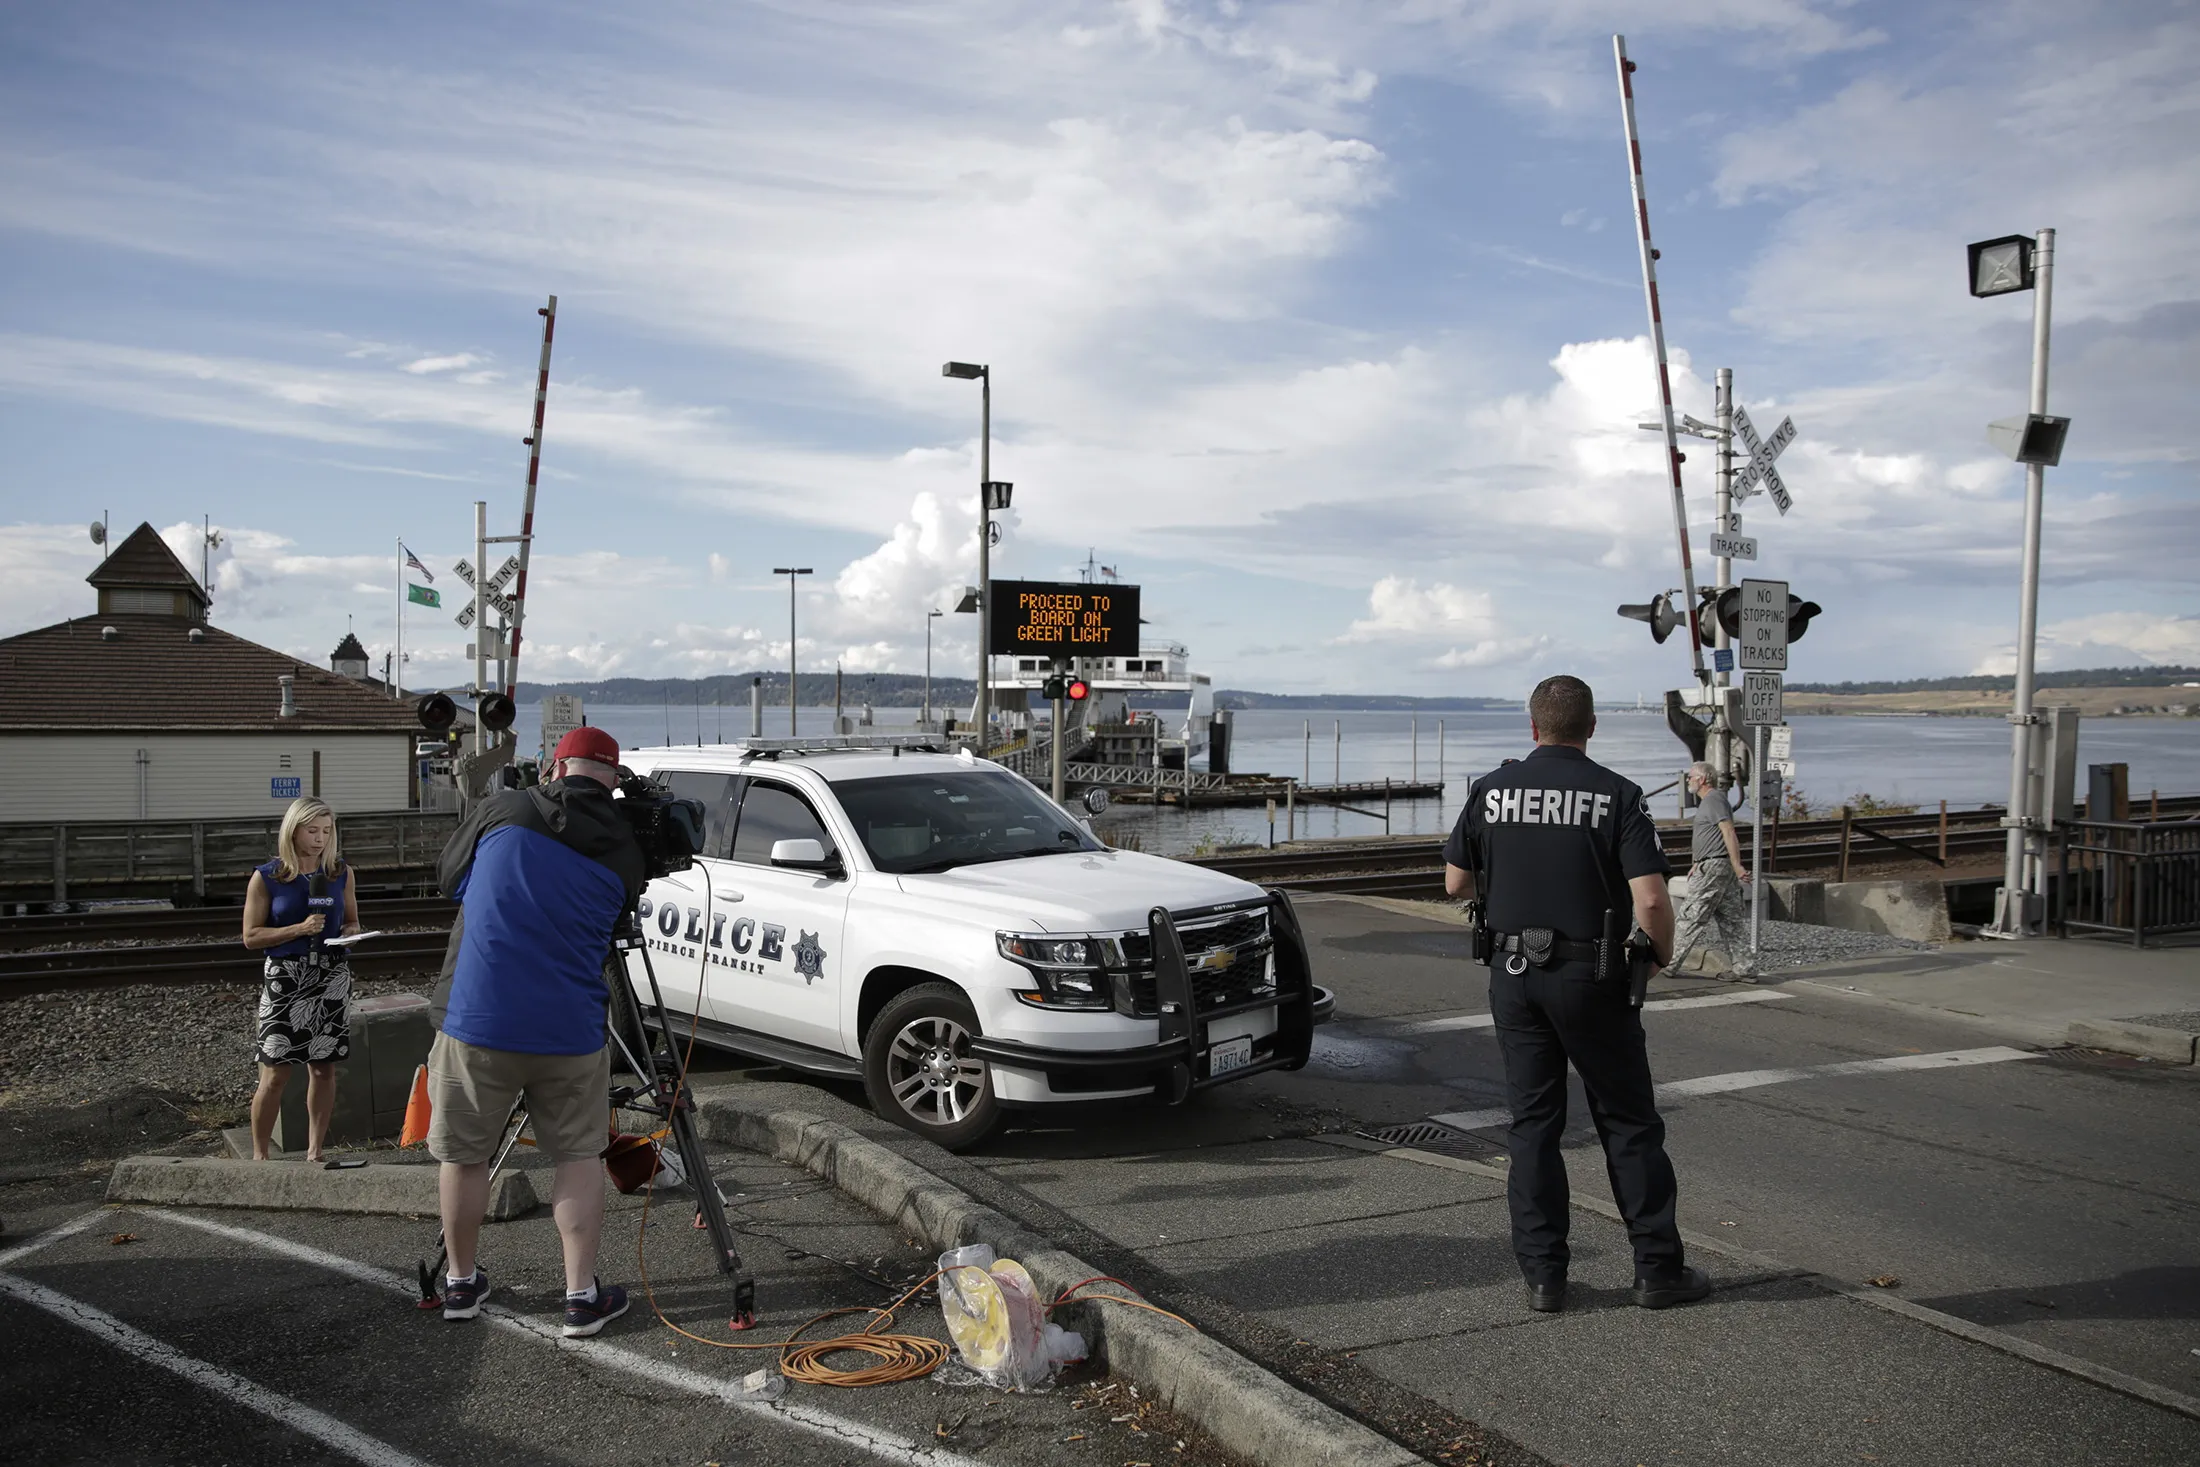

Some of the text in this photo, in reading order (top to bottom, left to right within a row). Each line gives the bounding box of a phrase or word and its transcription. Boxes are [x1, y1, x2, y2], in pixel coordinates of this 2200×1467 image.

[1734, 410, 1759, 456] RAIL
[1733, 421, 1794, 500] CROSSING
[1763, 467, 1790, 510] ROAD
[1730, 516, 1738, 532] 2
[1716, 539, 1752, 555] TRACKS
[456, 561, 476, 584] RAI
[458, 559, 519, 626] CRSING
[1757, 589, 1772, 604] NO
[491, 594, 514, 619] ROA
[1019, 593, 1110, 612] PROCEED TO
[1030, 609, 1101, 627] BOARD ON
[1743, 608, 1785, 623] STOPPING
[1017, 625, 1111, 643] GREEN LIGHT
[1757, 628, 1771, 641] ON
[1743, 646, 1784, 661] TRACKS
[1748, 677, 1779, 691] TURN
[1752, 692, 1775, 706] OFF
[1746, 708, 1780, 721] LIGHTS
[272, 787, 300, 797] TICKETS
[274, 778, 298, 788] FERRY
[1484, 788, 1611, 829] SHERIFF
[633, 897, 786, 962] POLICE
[647, 938, 765, 976] PIERCE TRANSIT
